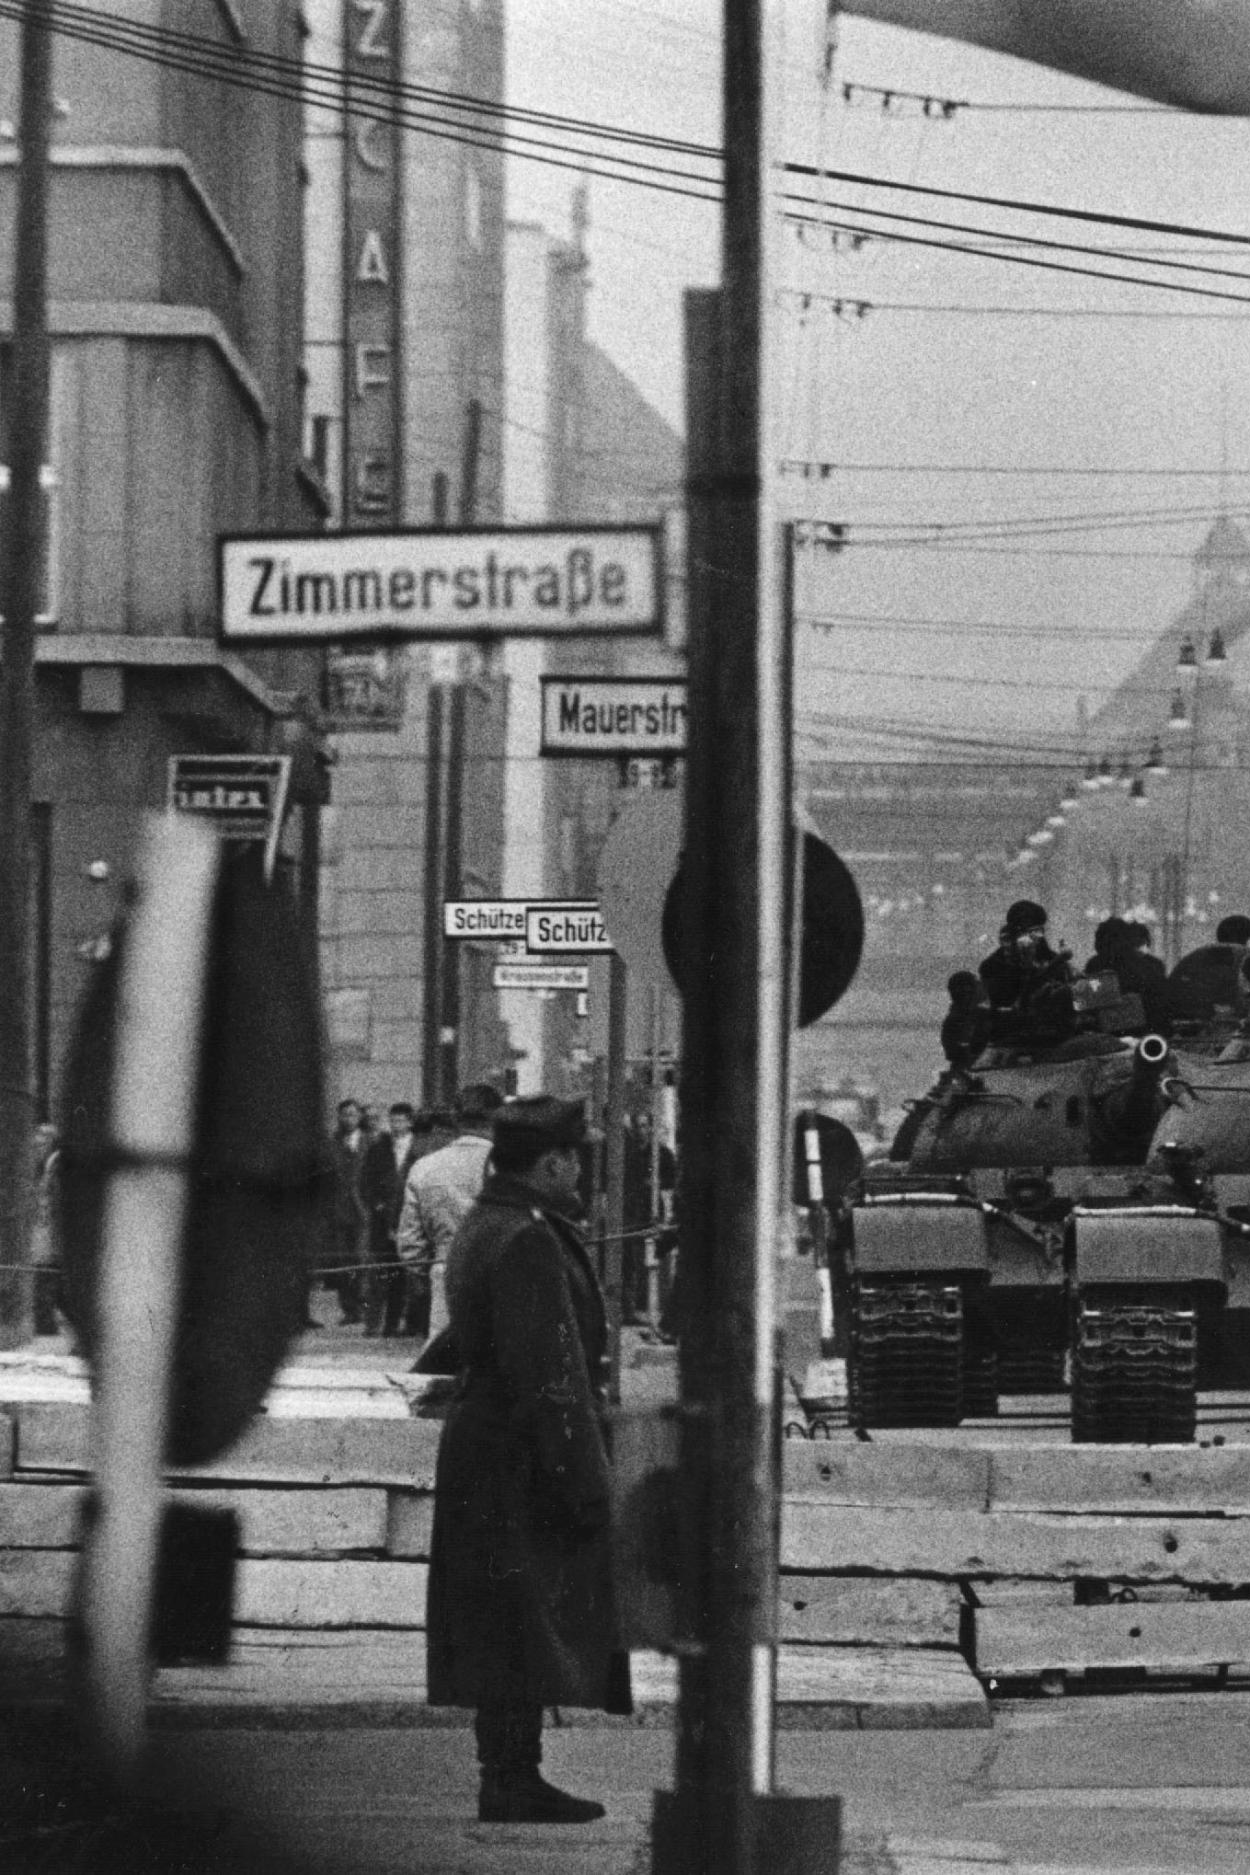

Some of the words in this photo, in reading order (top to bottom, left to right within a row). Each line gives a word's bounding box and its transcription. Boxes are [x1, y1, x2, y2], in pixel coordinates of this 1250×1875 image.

[248, 547, 627, 617] Zimmerstraße
[559, 692, 687, 735] Mauerstr
[454, 908, 525, 931] Schütze
[538, 917, 607, 943] Schütz
